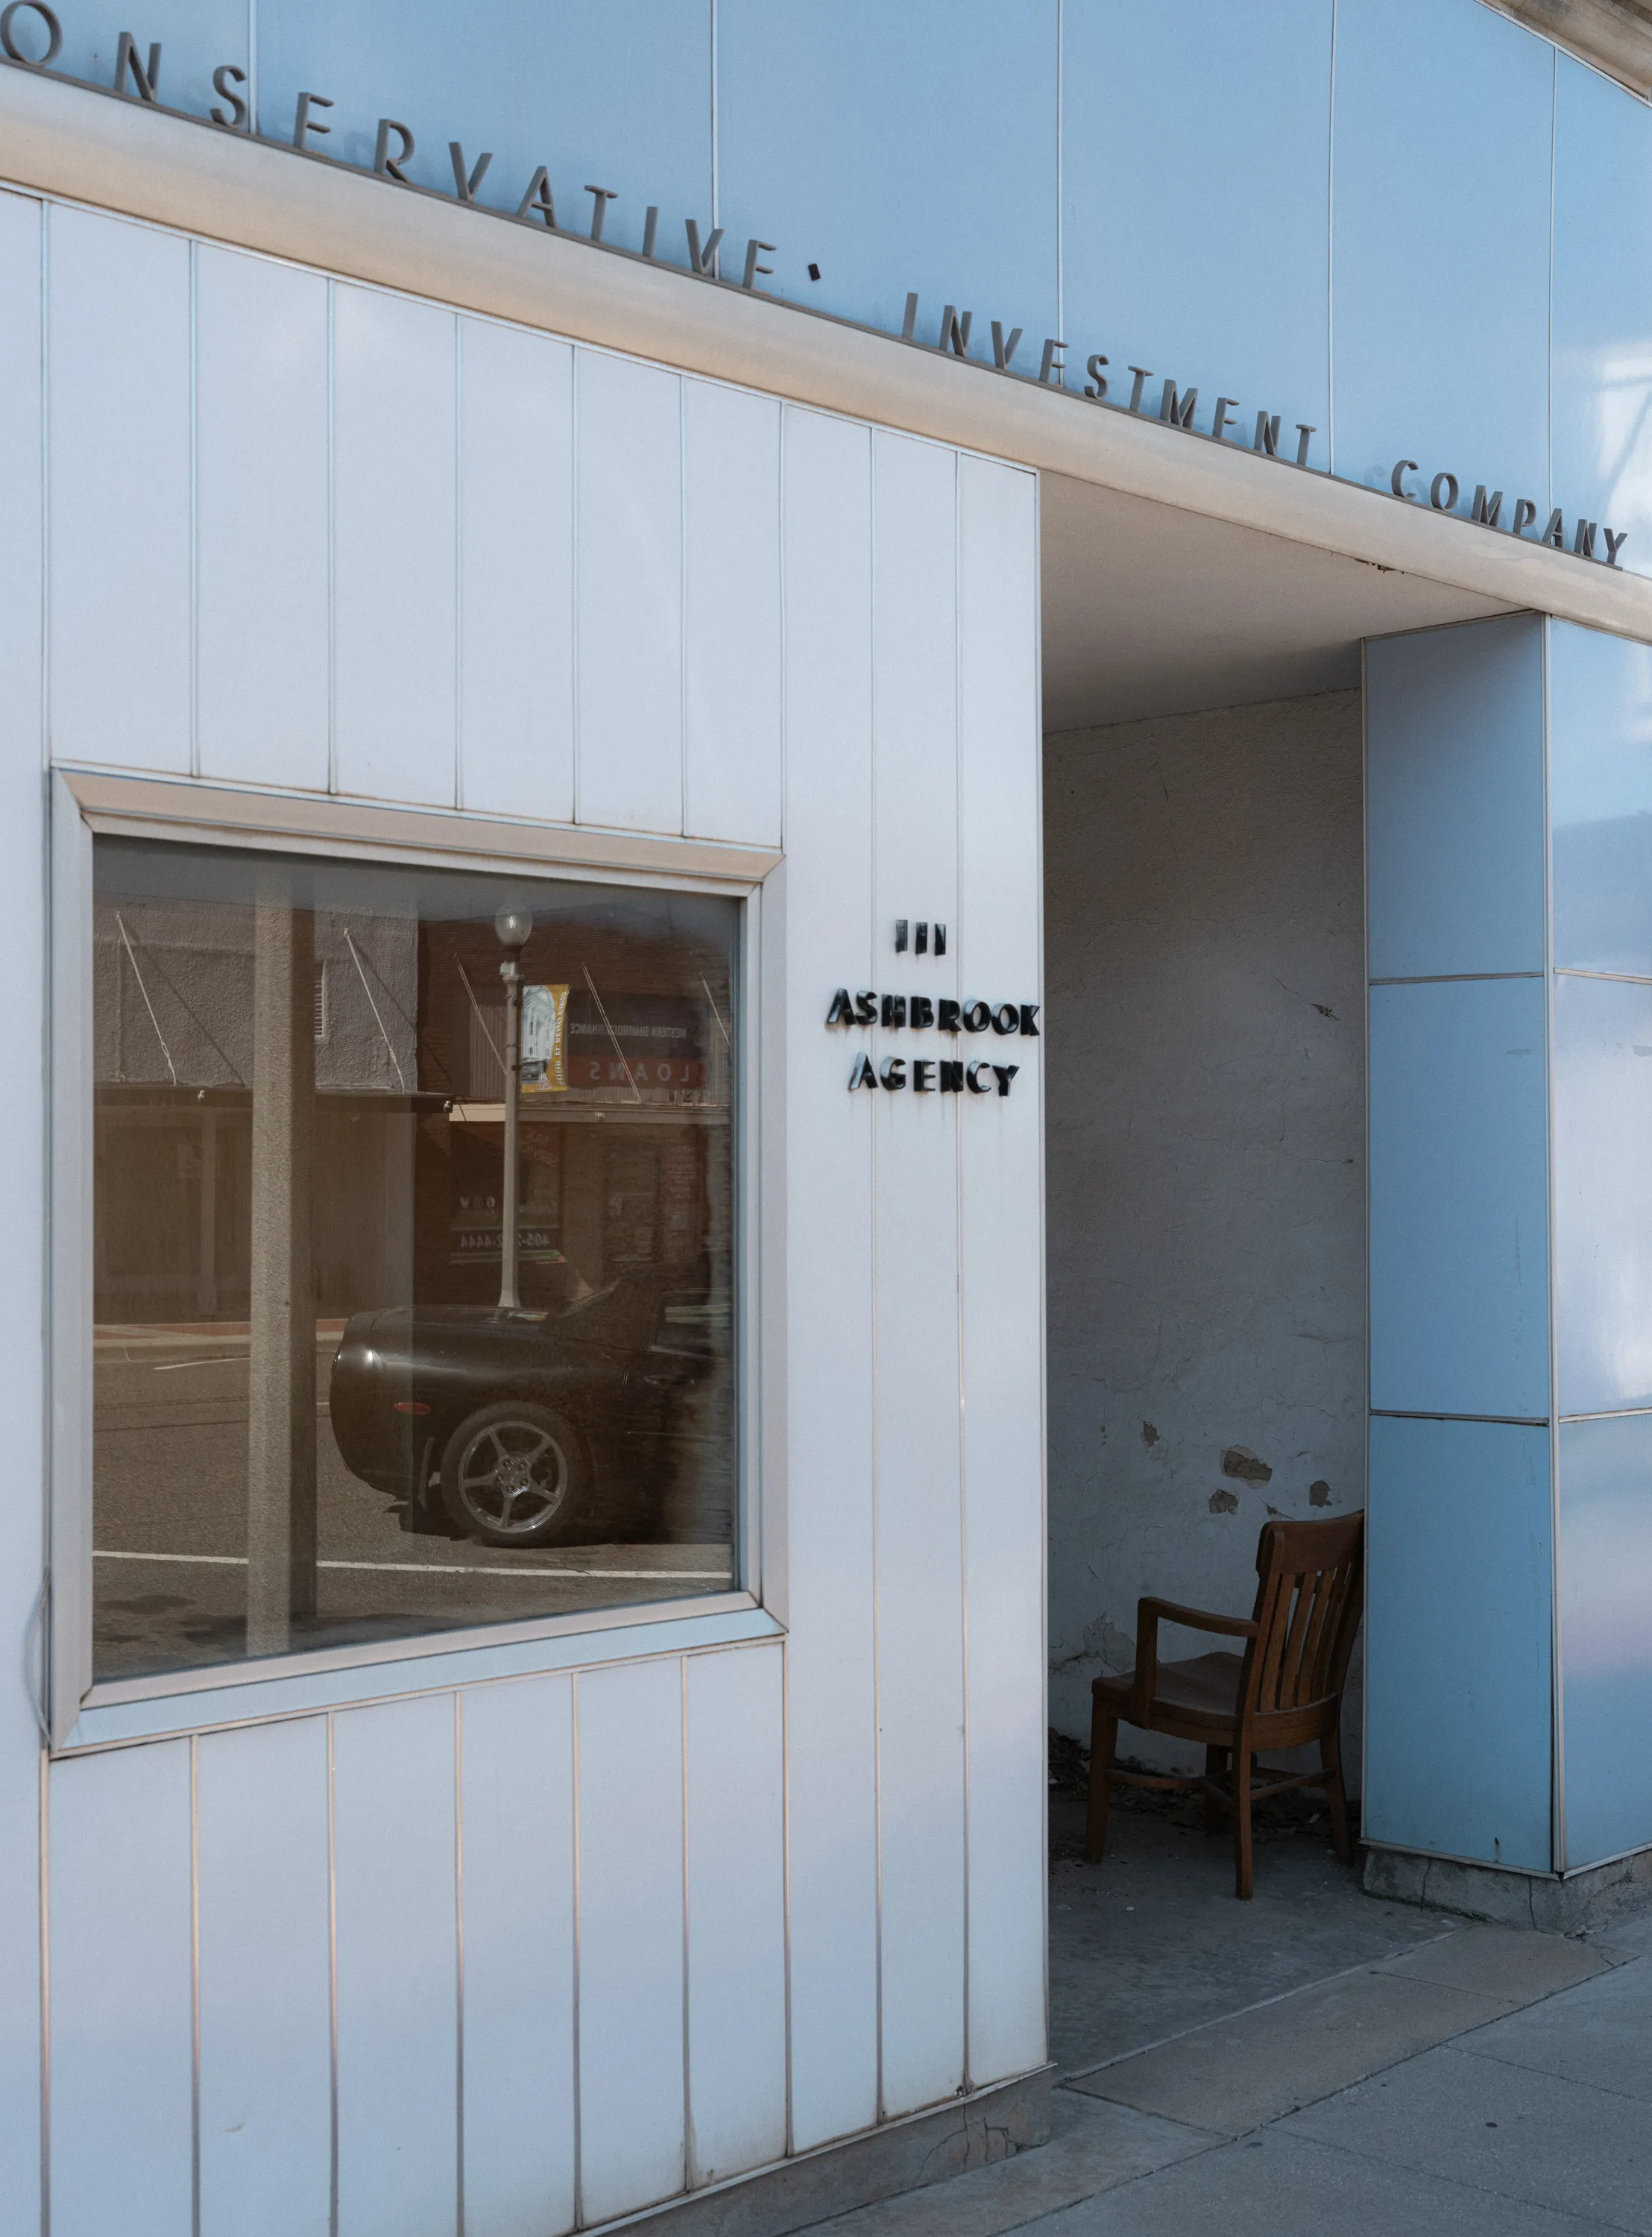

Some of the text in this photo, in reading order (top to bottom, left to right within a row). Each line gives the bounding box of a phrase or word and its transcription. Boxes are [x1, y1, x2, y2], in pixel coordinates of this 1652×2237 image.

[901, 292, 1317, 468] INVESTMENT
[1390, 459, 1629, 565] COMPANY
[825, 987, 1041, 1036] ASHBROOK
[848, 1051, 1020, 1098] AGENCY
